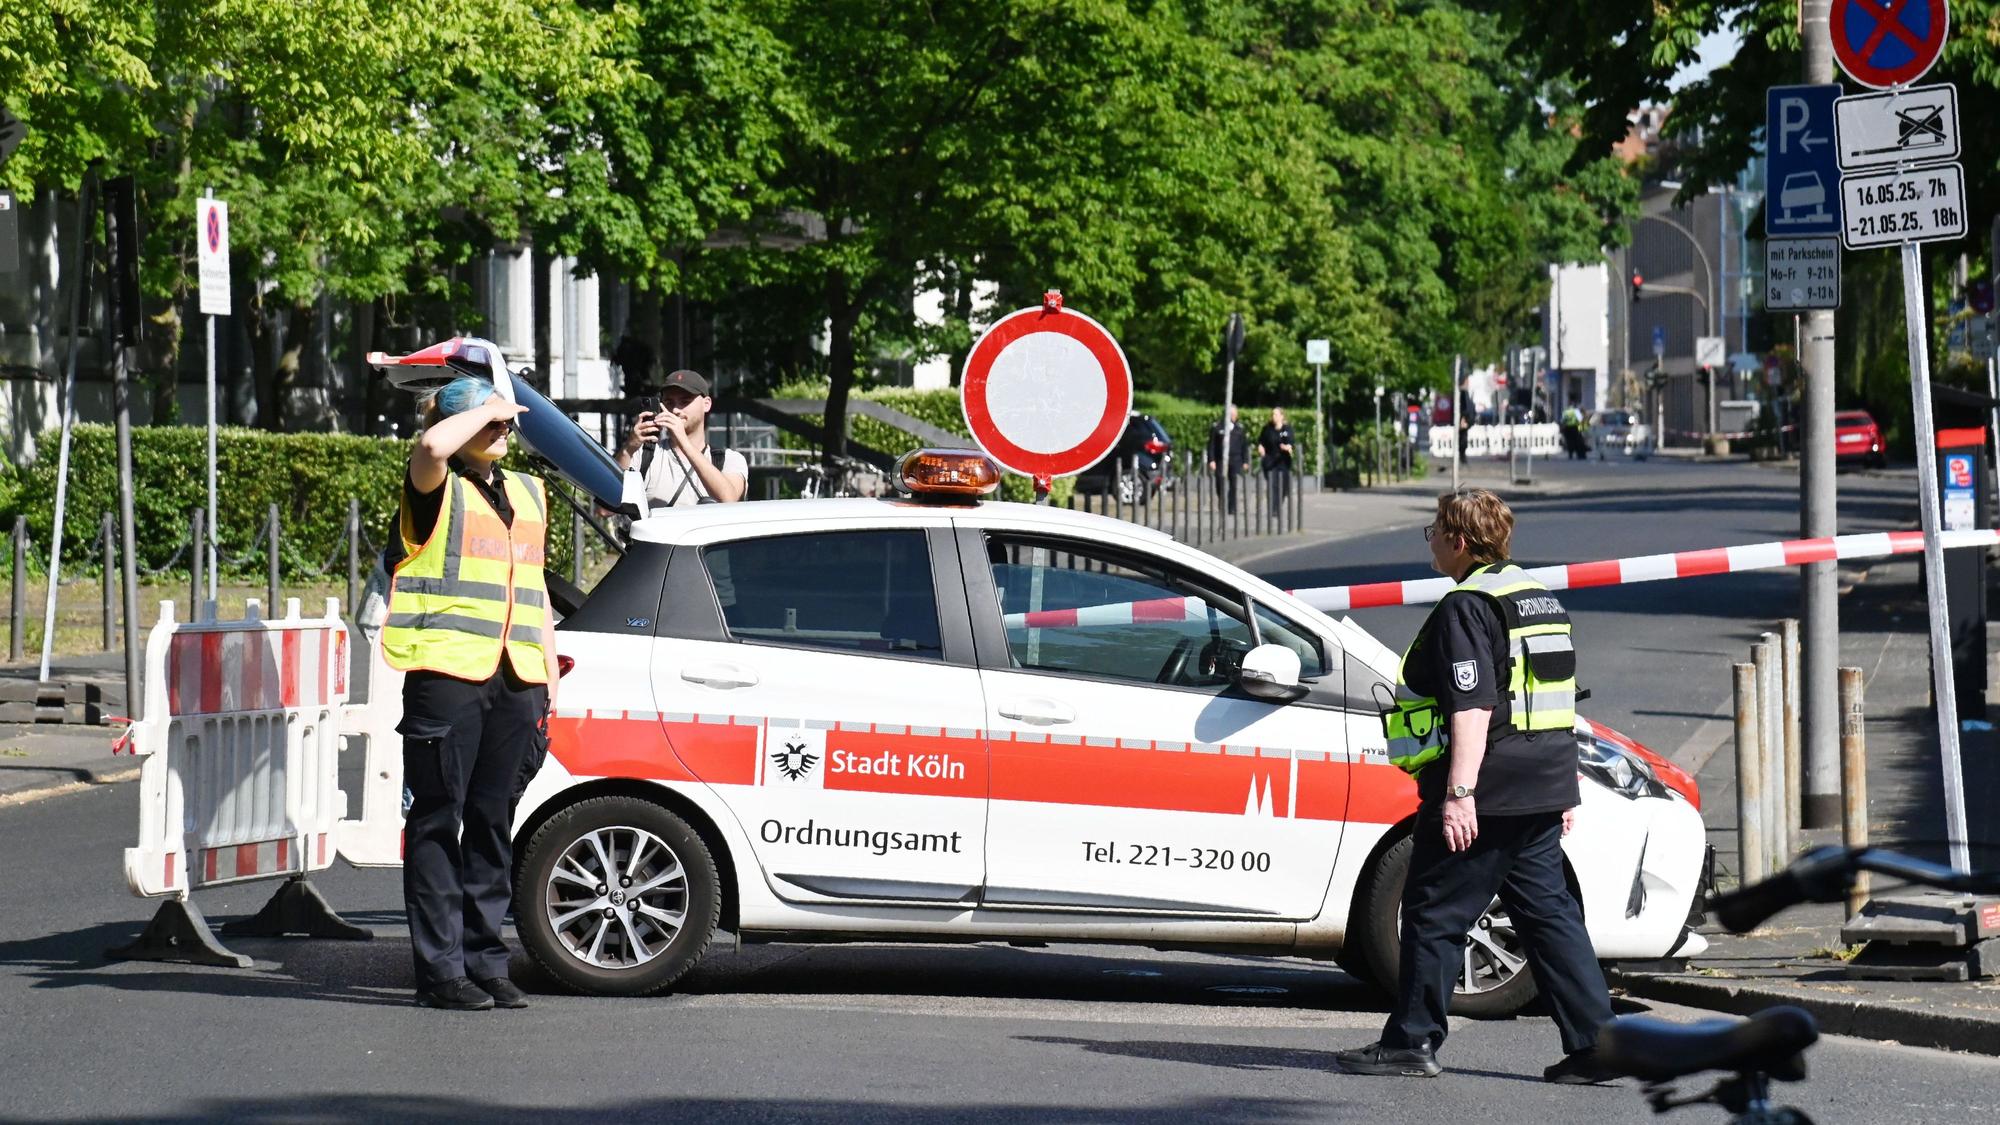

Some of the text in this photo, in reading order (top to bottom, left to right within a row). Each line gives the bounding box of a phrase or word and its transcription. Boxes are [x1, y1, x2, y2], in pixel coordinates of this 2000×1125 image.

[1928, 178, 1947, 198] 7h
[1932, 207, 1958, 228] 18h
[1771, 246, 1834, 261] mit Parkschein
[1771, 267, 1796, 280] Mo-Fr
[1771, 287, 1782, 300] Sa
[1361, 747, 1388, 756] HYB
[831, 749, 965, 780] Stadt Köln
[760, 819, 962, 856] Ordnungsamt
[1081, 841, 1271, 873] Tel. 221-320 00
